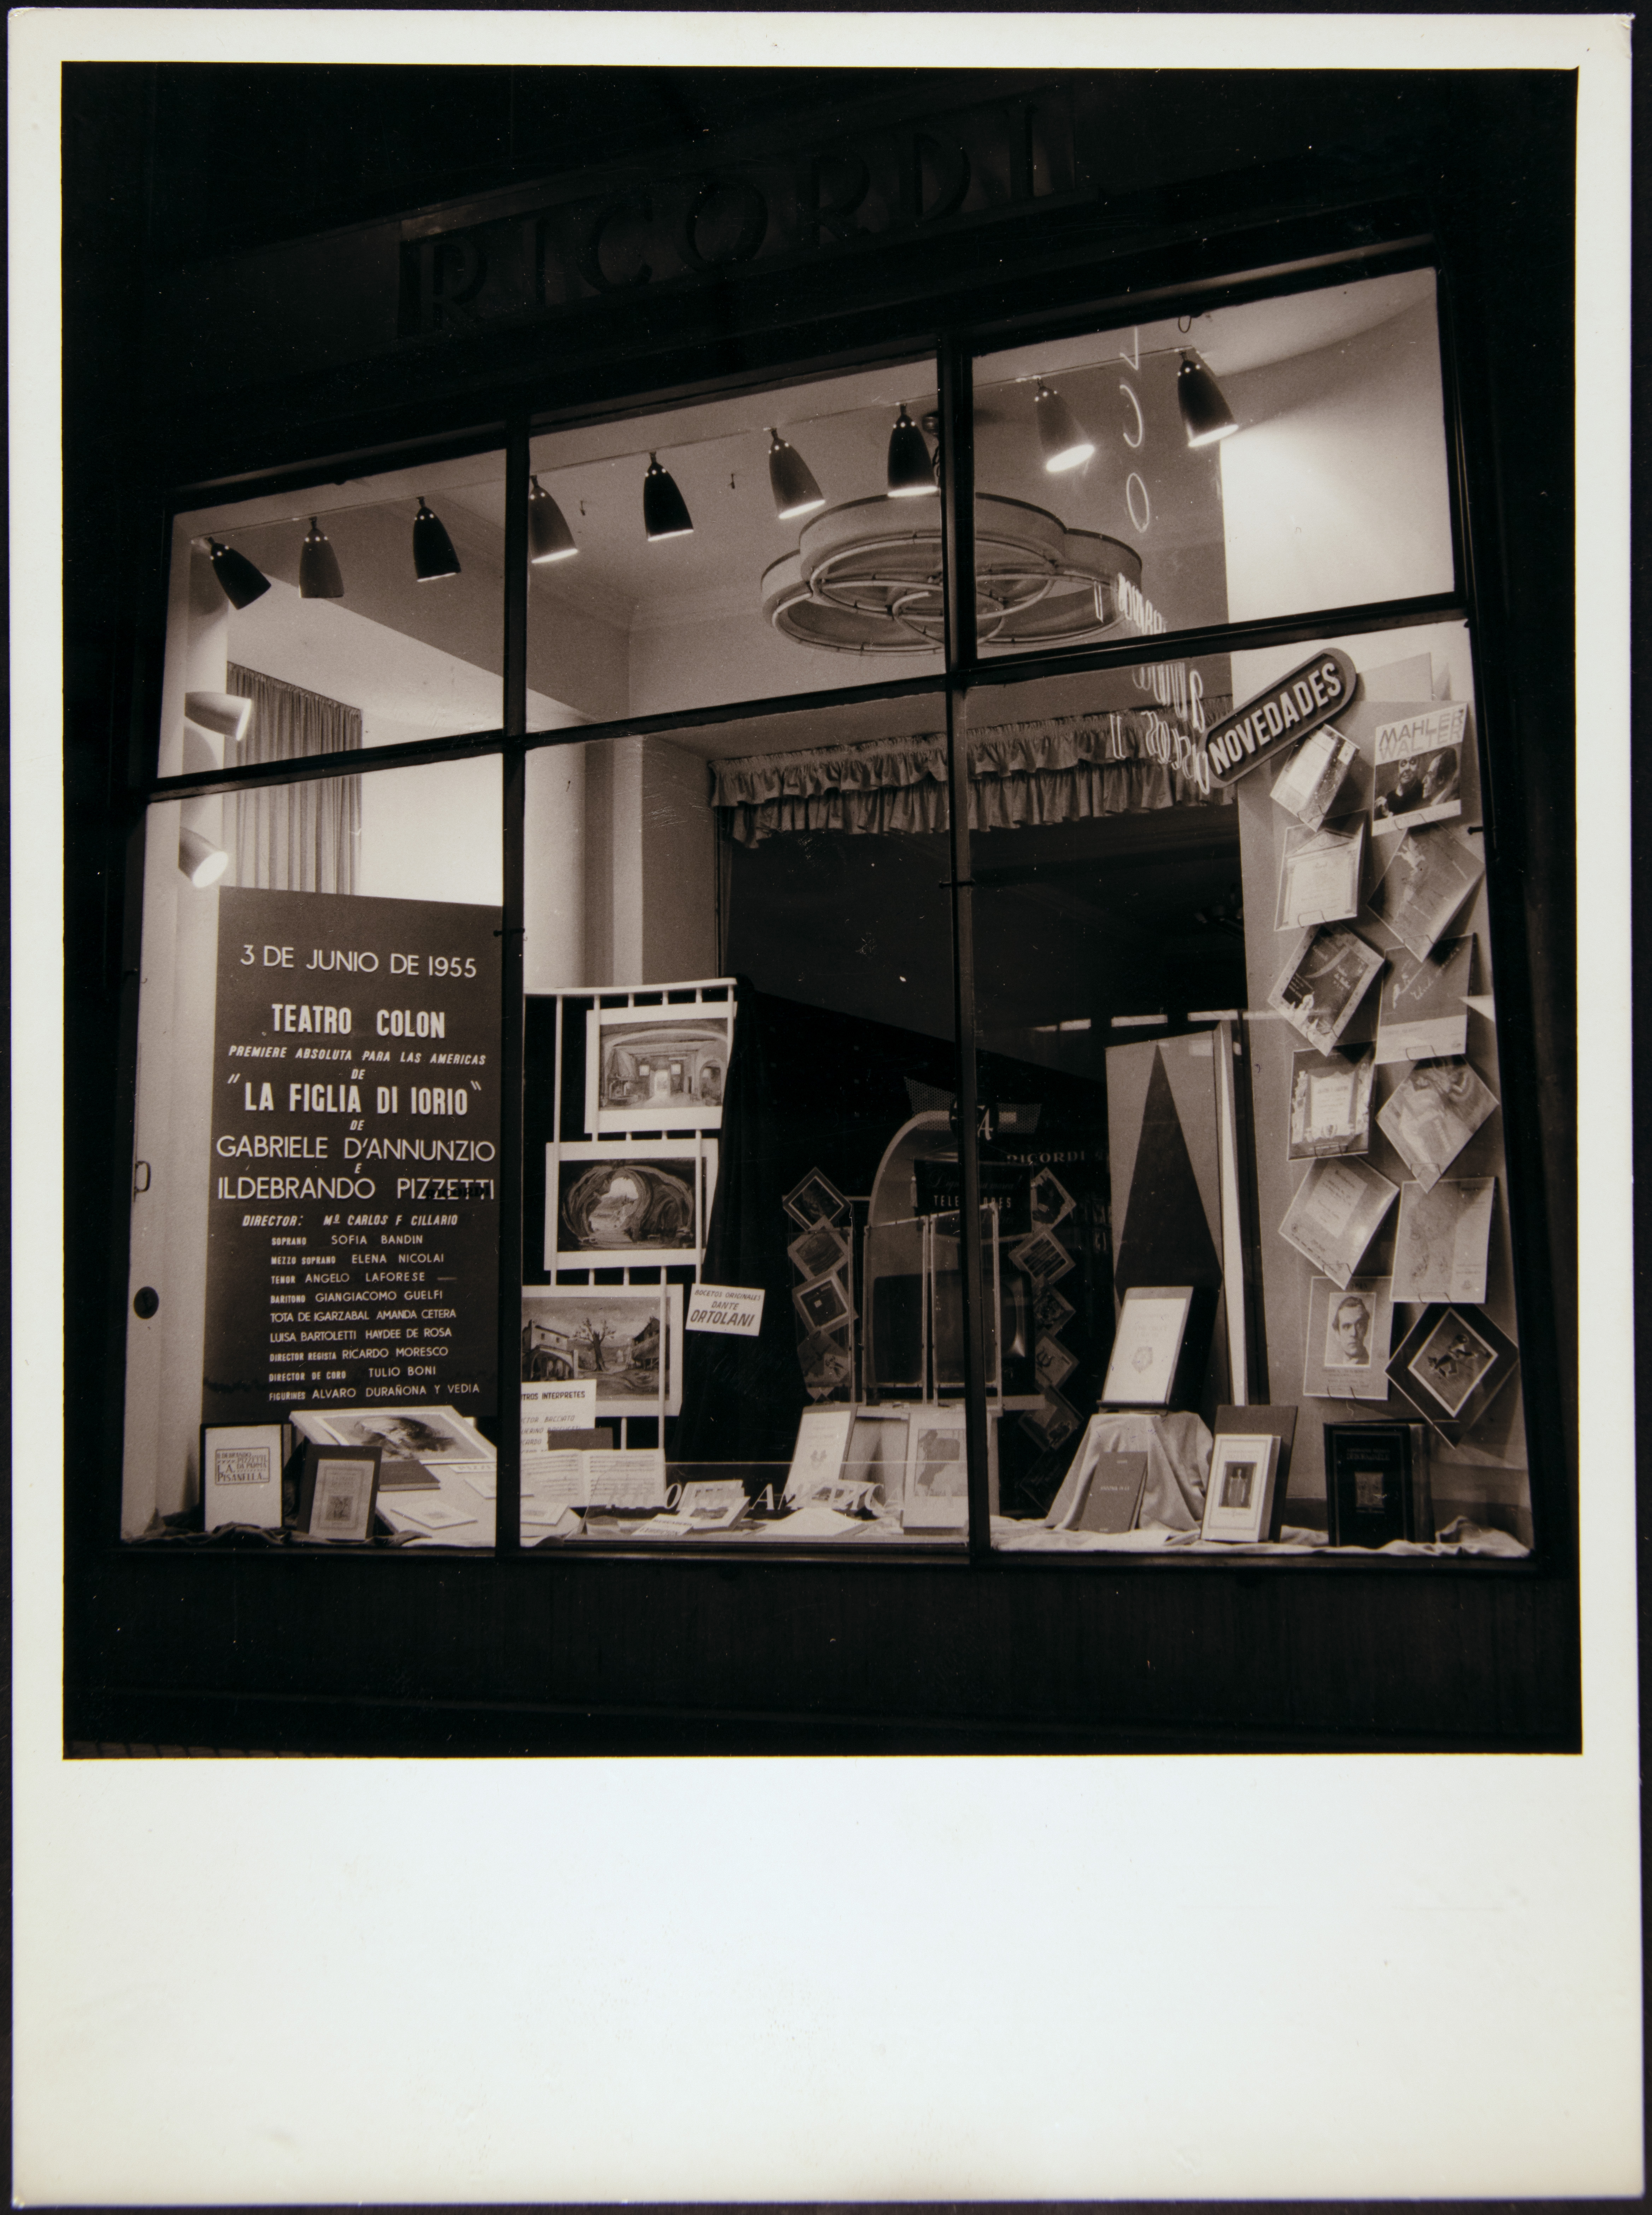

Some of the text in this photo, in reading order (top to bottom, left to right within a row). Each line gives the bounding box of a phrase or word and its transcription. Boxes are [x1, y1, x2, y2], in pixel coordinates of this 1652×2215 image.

[419, 105, 1040, 330] RICORDI
[1209, 663, 1341, 774] NOVEDADES
[1379, 708, 1464, 747] MAHLER
[1379, 724, 1462, 760] WALTER
[241, 945, 476, 978] 3 DE JUNIO DE 1955
[272, 1004, 445, 1038] TEATRO COLON
[229, 1045, 486, 1065] PREMIERE ABSOLUTA PARA LAS AMERICAS
[351, 1069, 365, 1079] DE
[227, 1074, 481, 1116] "LA FIGLIA DI IORIO"
[350, 1120, 364, 1130] DE
[216, 1135, 495, 1161] GABRIELE D'ANNUNZIO
[355, 1163, 361, 1173] E
[218, 1177, 494, 1200] ILDEBRANDO PIZZETTI
[242, 1215, 303, 1226] DIRECTOR:
[348, 1215, 388, 1225] CARLOS
[396, 1215, 402, 1225] F
[411, 1215, 458, 1225] CILLARIO
[331, 1235, 367, 1244] SOFIA
[381, 1235, 422, 1244] BANDIN
[302, 1256, 335, 1265] SOPRANO
[352, 1254, 386, 1263] ELENA
[399, 1254, 443, 1263] NICOLAI
[305, 1273, 349, 1283] ANGELO
[366, 1272, 424, 1282] LAFORESE
[271, 1290, 442, 1303] BARITONO GIANGIACOMO GUELFI
[695, 1289, 761, 1301] BOCETOS ORIGINALES
[711, 1301, 739, 1310] DANTE
[271, 1309, 456, 1322] TOTA DE IGARZABAL AMANDA CETERA
[690, 1309, 755, 1327] ORTOLANI
[270, 1328, 452, 1342] LUISA BARTOLETTI HAYDEE DE ROSA
[270, 1353, 304, 1361] DIRECTOR
[342, 1348, 389, 1359] RICARDO
[396, 1347, 448, 1356] MORESCO
[269, 1366, 435, 1382] DIRECTOR DE CORO TULIO BONI
[270, 1384, 479, 1400] FIGURINES ALVARO DURAÑONA Y VEDIA
[542, 1391, 585, 1399] INTERPRETES
